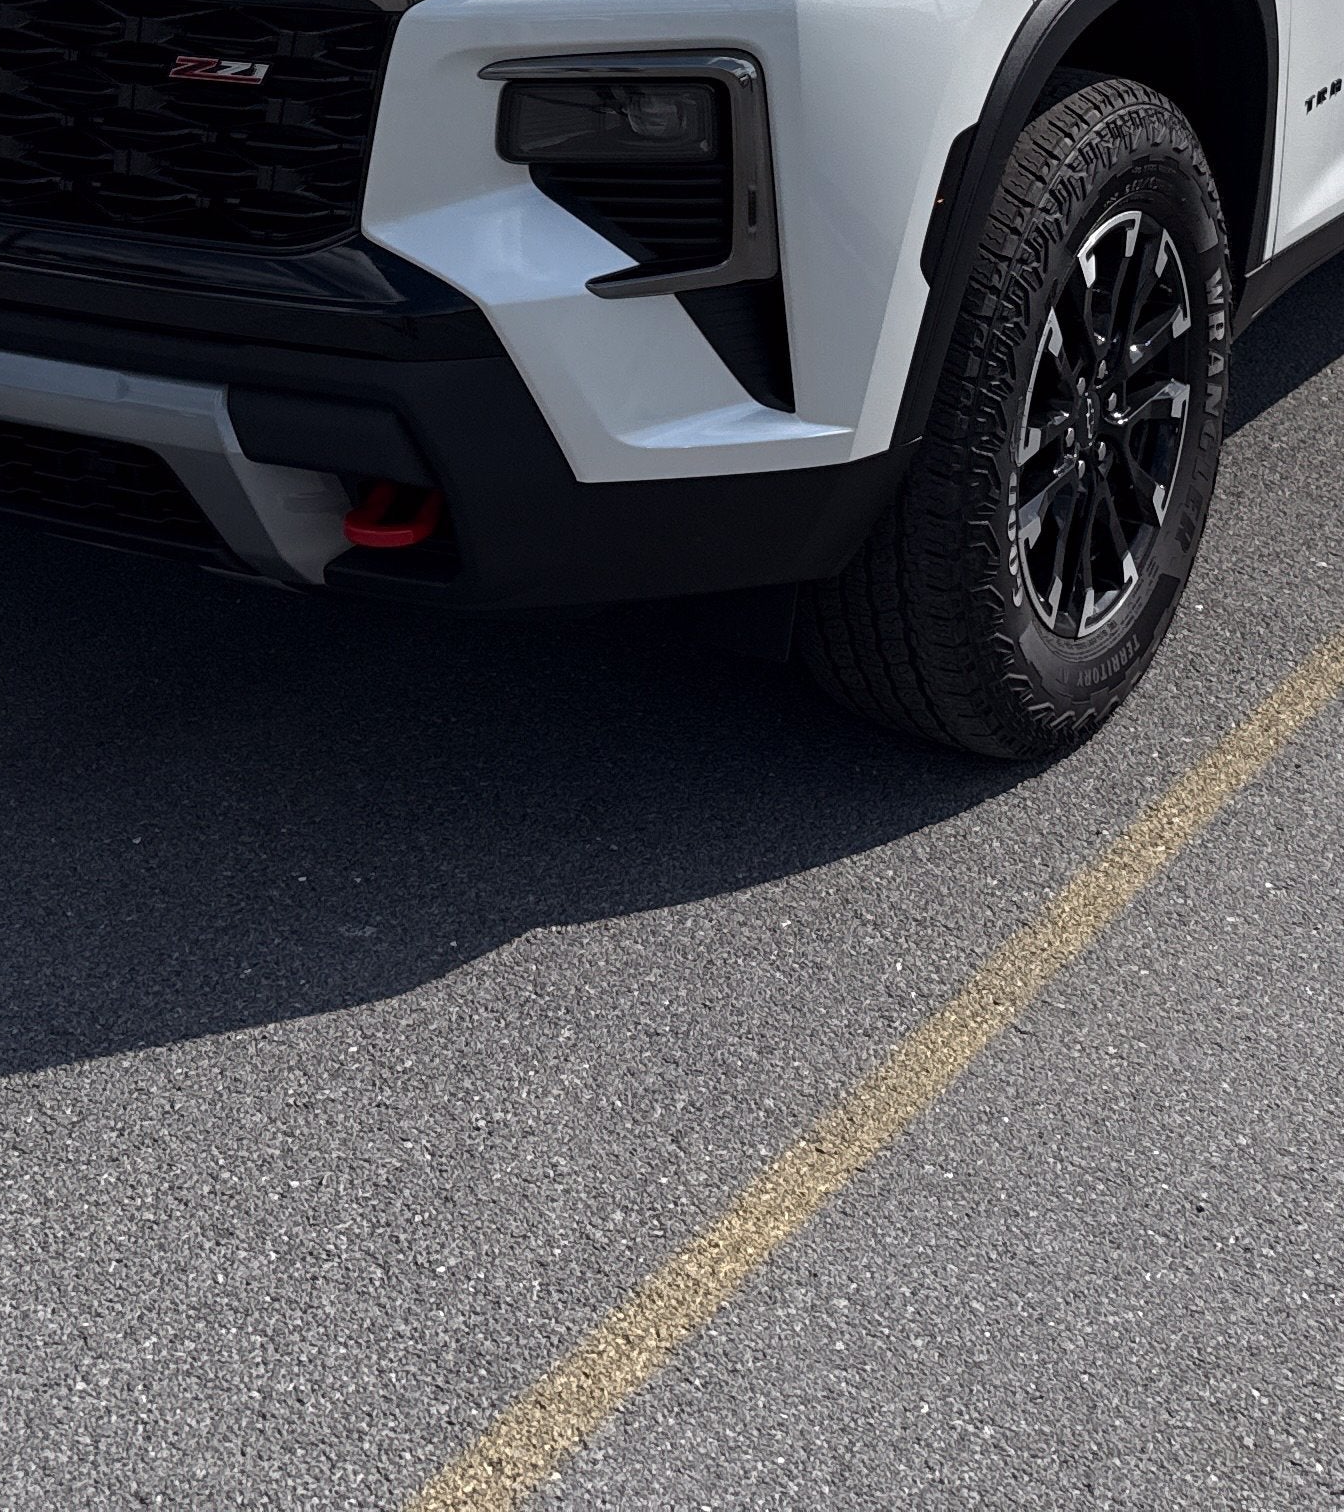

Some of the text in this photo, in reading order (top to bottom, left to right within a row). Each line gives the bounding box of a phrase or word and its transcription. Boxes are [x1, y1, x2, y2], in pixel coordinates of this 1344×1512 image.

[169, 56, 269, 84] Z71
[1175, 268, 1225, 553] WRANGLER
[1077, 634, 1141, 687] TERRITORY
